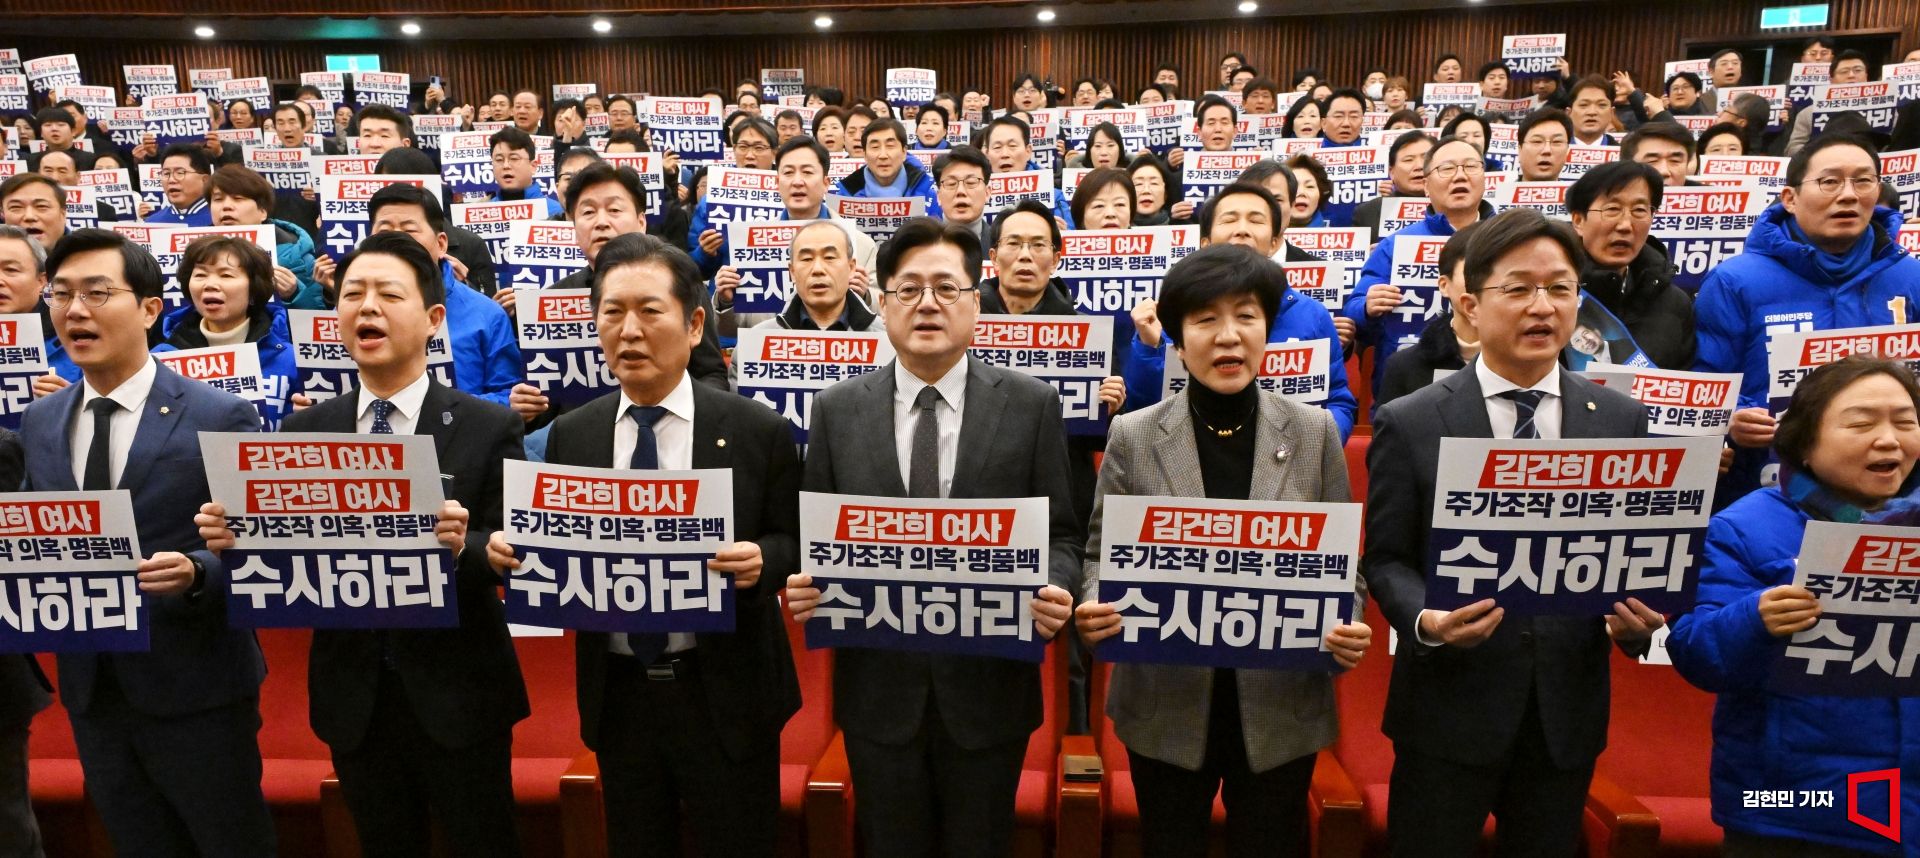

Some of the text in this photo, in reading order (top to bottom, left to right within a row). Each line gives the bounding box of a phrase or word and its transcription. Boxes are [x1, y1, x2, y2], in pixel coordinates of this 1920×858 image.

[886, 87, 936, 102] 수사하라
[657, 102, 707, 115] 김건희 여사
[147, 118, 210, 138] 수사하라
[649, 114, 675, 125] 주가조작
[651, 130, 722, 153] 수사하라
[1200, 156, 1231, 168] 김건희
[1349, 151, 1373, 164] 여사
[1887, 156, 1912, 173] 여사
[1186, 171, 1221, 180] 주가조작
[1709, 161, 1775, 175] 김건희 여사
[726, 173, 761, 188] 김건희
[1005, 177, 1034, 192] 여사
[710, 187, 749, 199] 주가조작
[1518, 188, 1559, 203] 김건희
[1706, 193, 1743, 213] 여사
[467, 204, 530, 222] 김건희 여사
[842, 202, 907, 215] 김건희 여사
[533, 227, 575, 244] 김건희
[752, 228, 796, 245] 김건희
[1065, 236, 1147, 255] 김건희 여사
[1320, 232, 1350, 249] 여사
[513, 245, 562, 260] 주가조작
[734, 248, 783, 262] 주가조작
[1057, 255, 1167, 270] 가조작 의혹·명품백
[1286, 268, 1319, 287] 여사
[1397, 264, 1439, 279] 주가조
[736, 270, 796, 304] 수사
[1764, 312, 1813, 323] 더불어민주당
[522, 322, 583, 341] 주가조작
[974, 324, 1080, 347] 김건희 여사
[768, 339, 870, 362] 김건희 여사
[1015, 350, 1105, 368] 의혹·명품백
[187, 354, 229, 378] 여사
[743, 362, 806, 381] 주가조작
[1265, 351, 1306, 374] 여사
[1259, 374, 1326, 395] 혹·명품백
[1692, 383, 1724, 406] 여사
[1494, 452, 1668, 487] 김건희 여사
[254, 482, 401, 511] 김건희 여사
[542, 477, 687, 514] 김건희 여사
[1445, 489, 1704, 519] 주가조작 의혹·명품백
[38, 504, 93, 533] 여사
[228, 515, 439, 538] 주가조작 의혹·명품백
[510, 508, 725, 542] 주가조작 의혹·명품백
[847, 509, 1003, 543] 김건희 여사
[1152, 510, 1313, 548] 김건희 여사
[18, 537, 134, 561] 의혹·명품백
[809, 541, 1040, 573] 주가조작 의혹·명품백
[1110, 544, 1348, 579] 주가조작 의혹·명품백
[1436, 533, 1693, 595] 수사하라
[231, 553, 447, 609] 수사하라
[509, 552, 727, 613] 수사하라
[0, 575, 142, 632] 사하라
[1108, 587, 1343, 653] 수사하라
[1785, 618, 1920, 679] 수사
